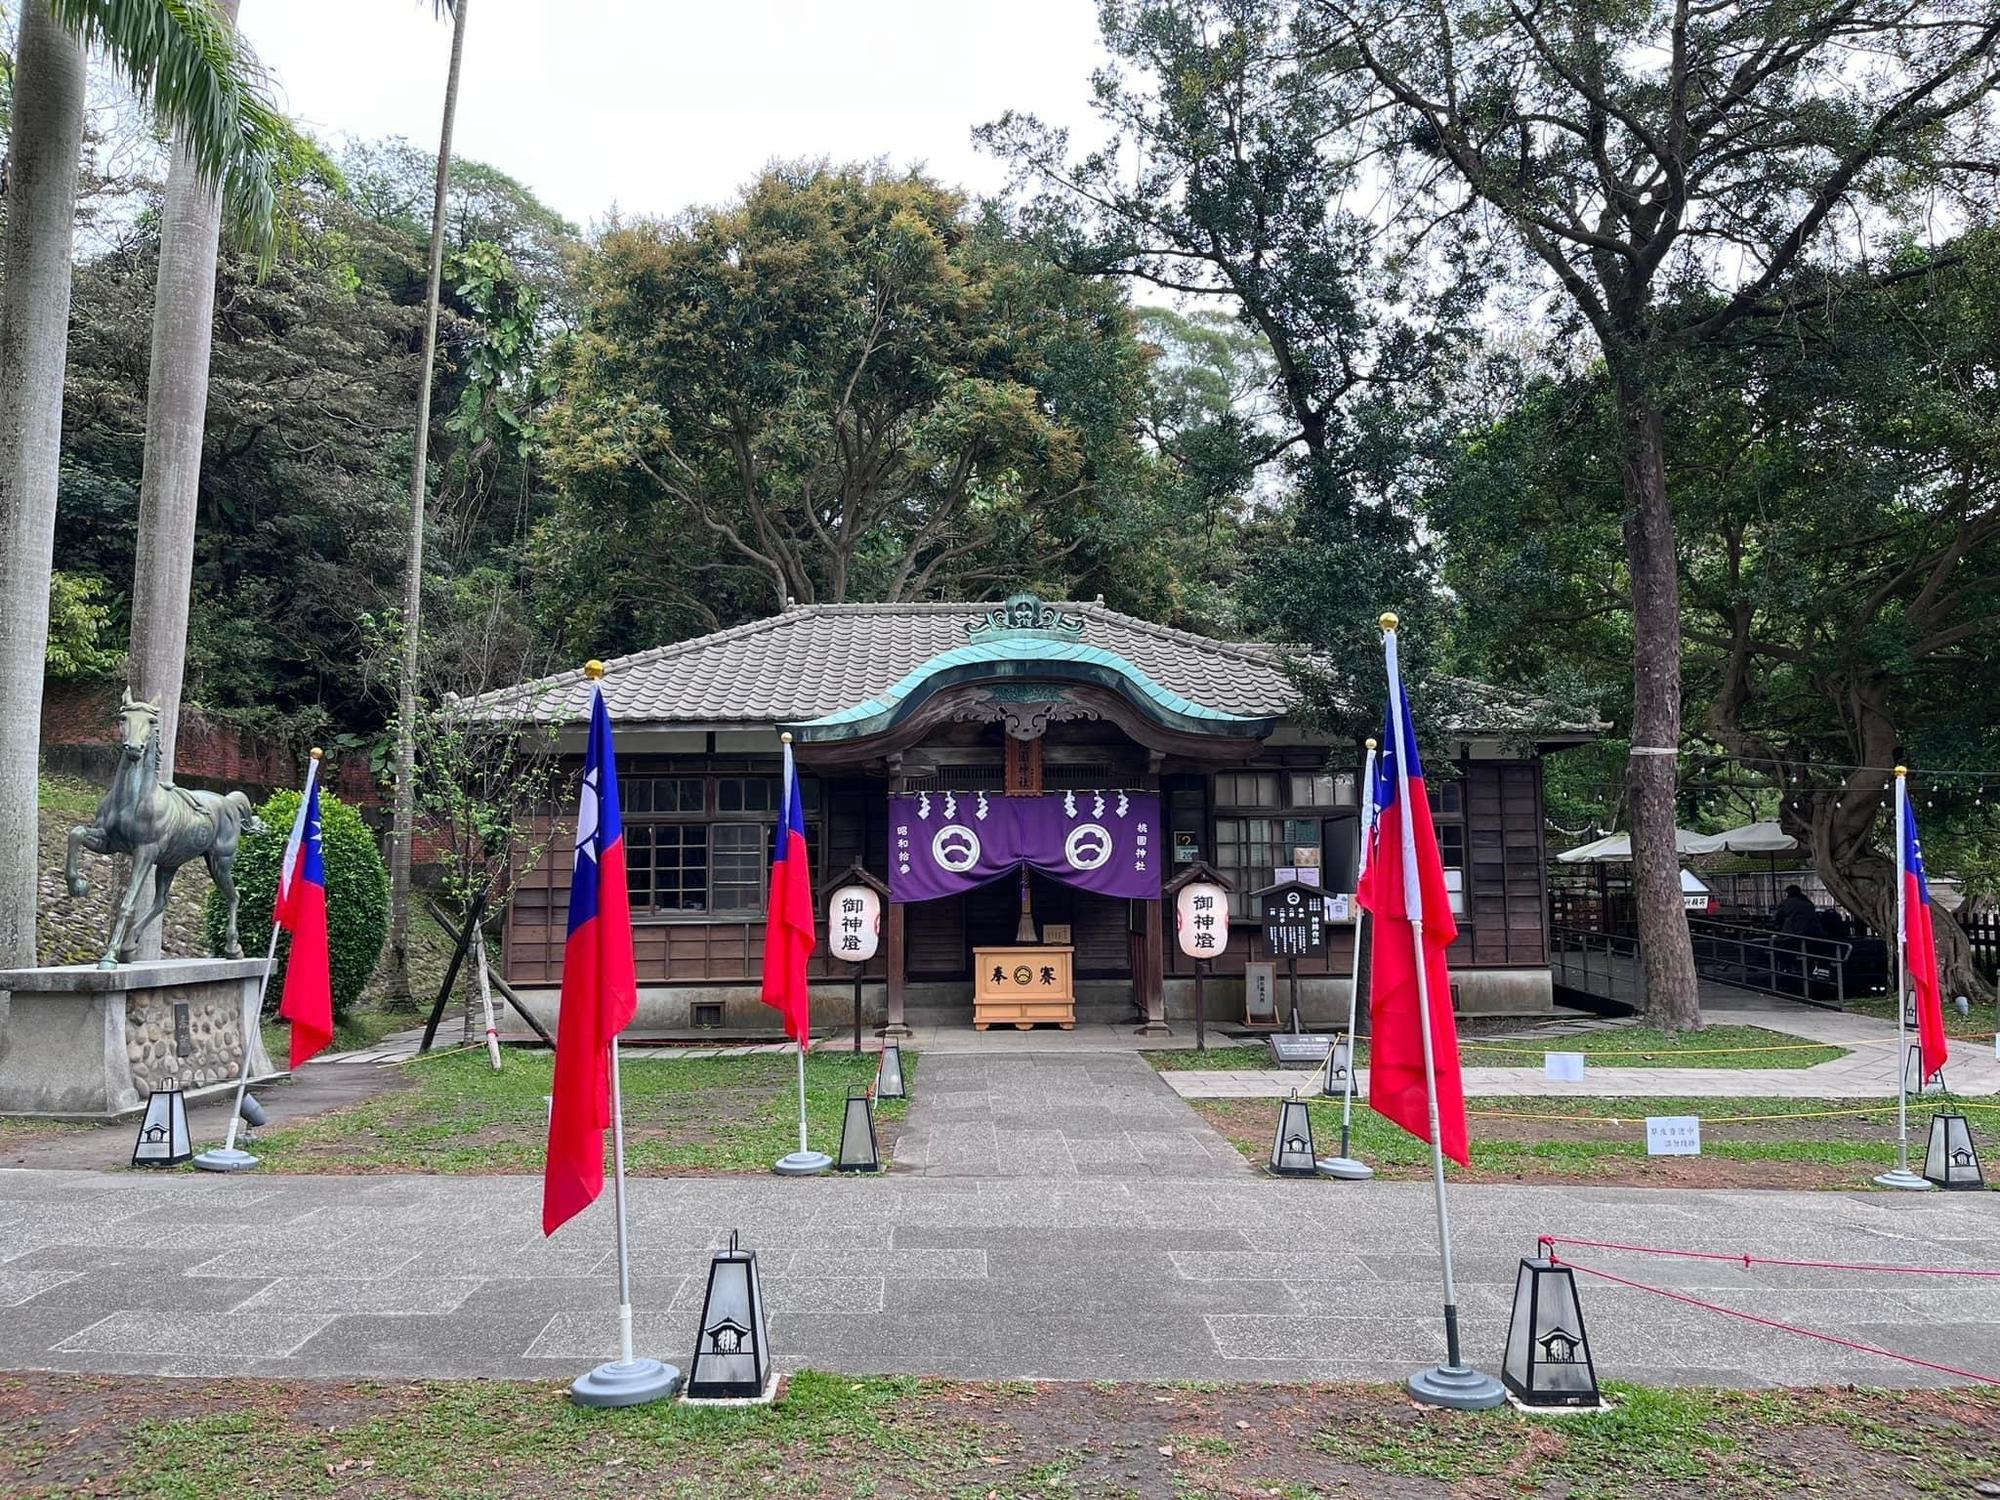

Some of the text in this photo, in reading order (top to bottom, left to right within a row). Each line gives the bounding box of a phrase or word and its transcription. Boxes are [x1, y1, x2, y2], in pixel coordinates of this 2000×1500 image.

[841, 897, 864, 951] 御神燈
[1193, 894, 1216, 949] 御神燈
